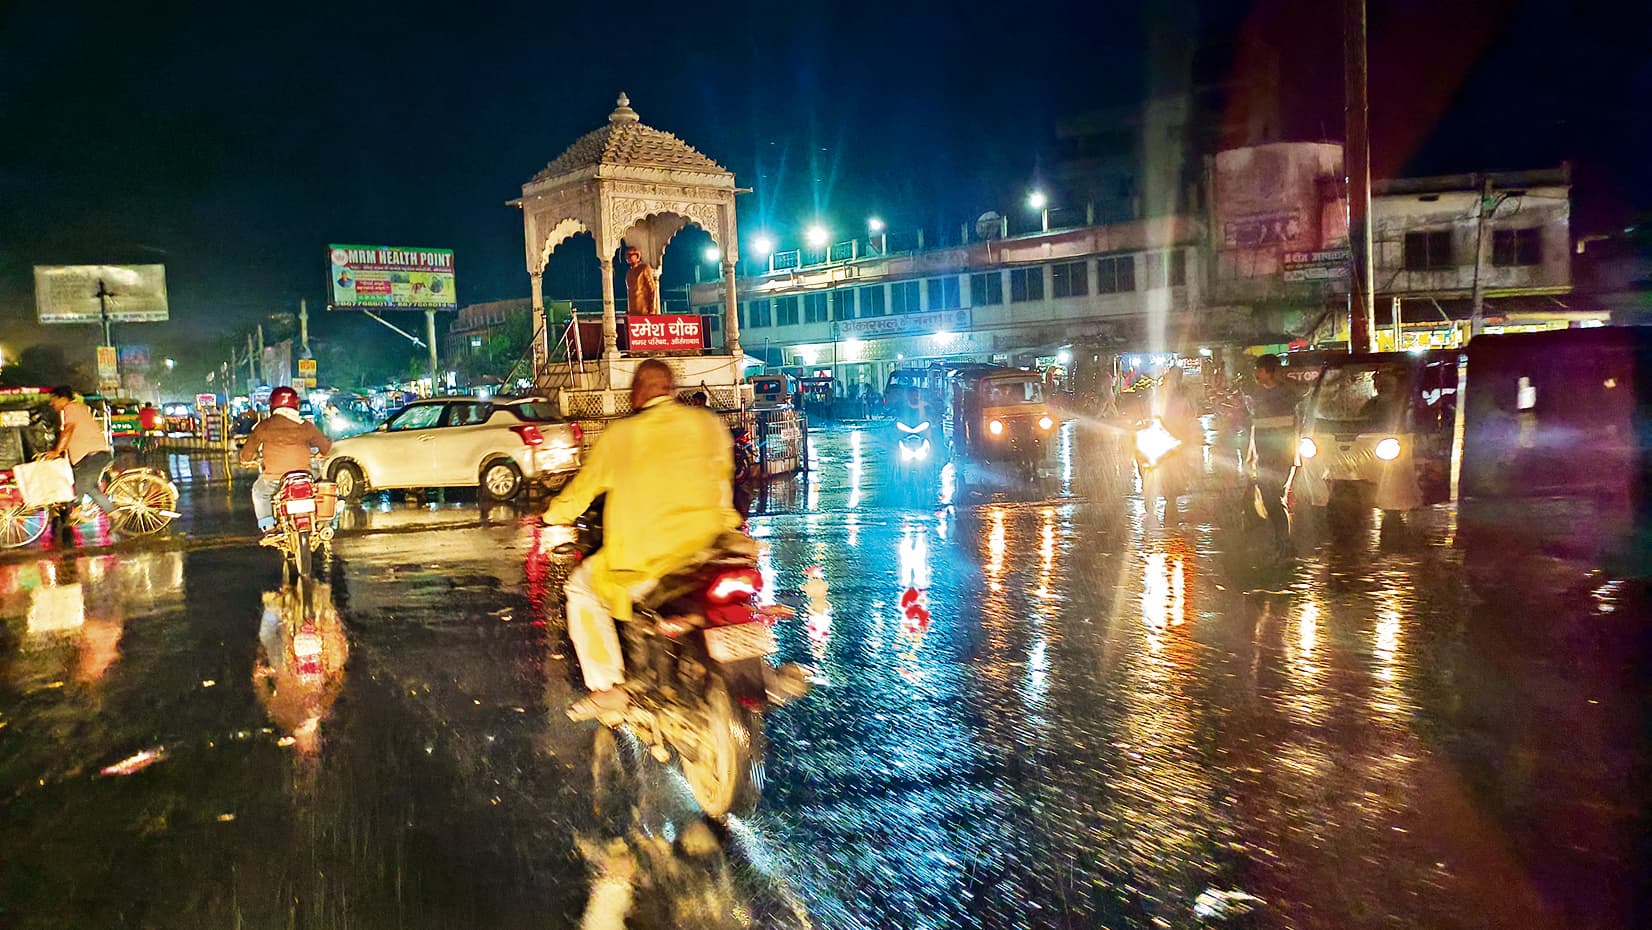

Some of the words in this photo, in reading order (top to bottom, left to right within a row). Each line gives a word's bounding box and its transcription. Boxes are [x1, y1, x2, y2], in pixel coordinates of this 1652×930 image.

[348, 249, 376, 264] MRM
[379, 250, 418, 266] HEALTH
[420, 251, 451, 267] POINT
[630, 317, 665, 337] रमेश
[668, 317, 699, 337] चौक
